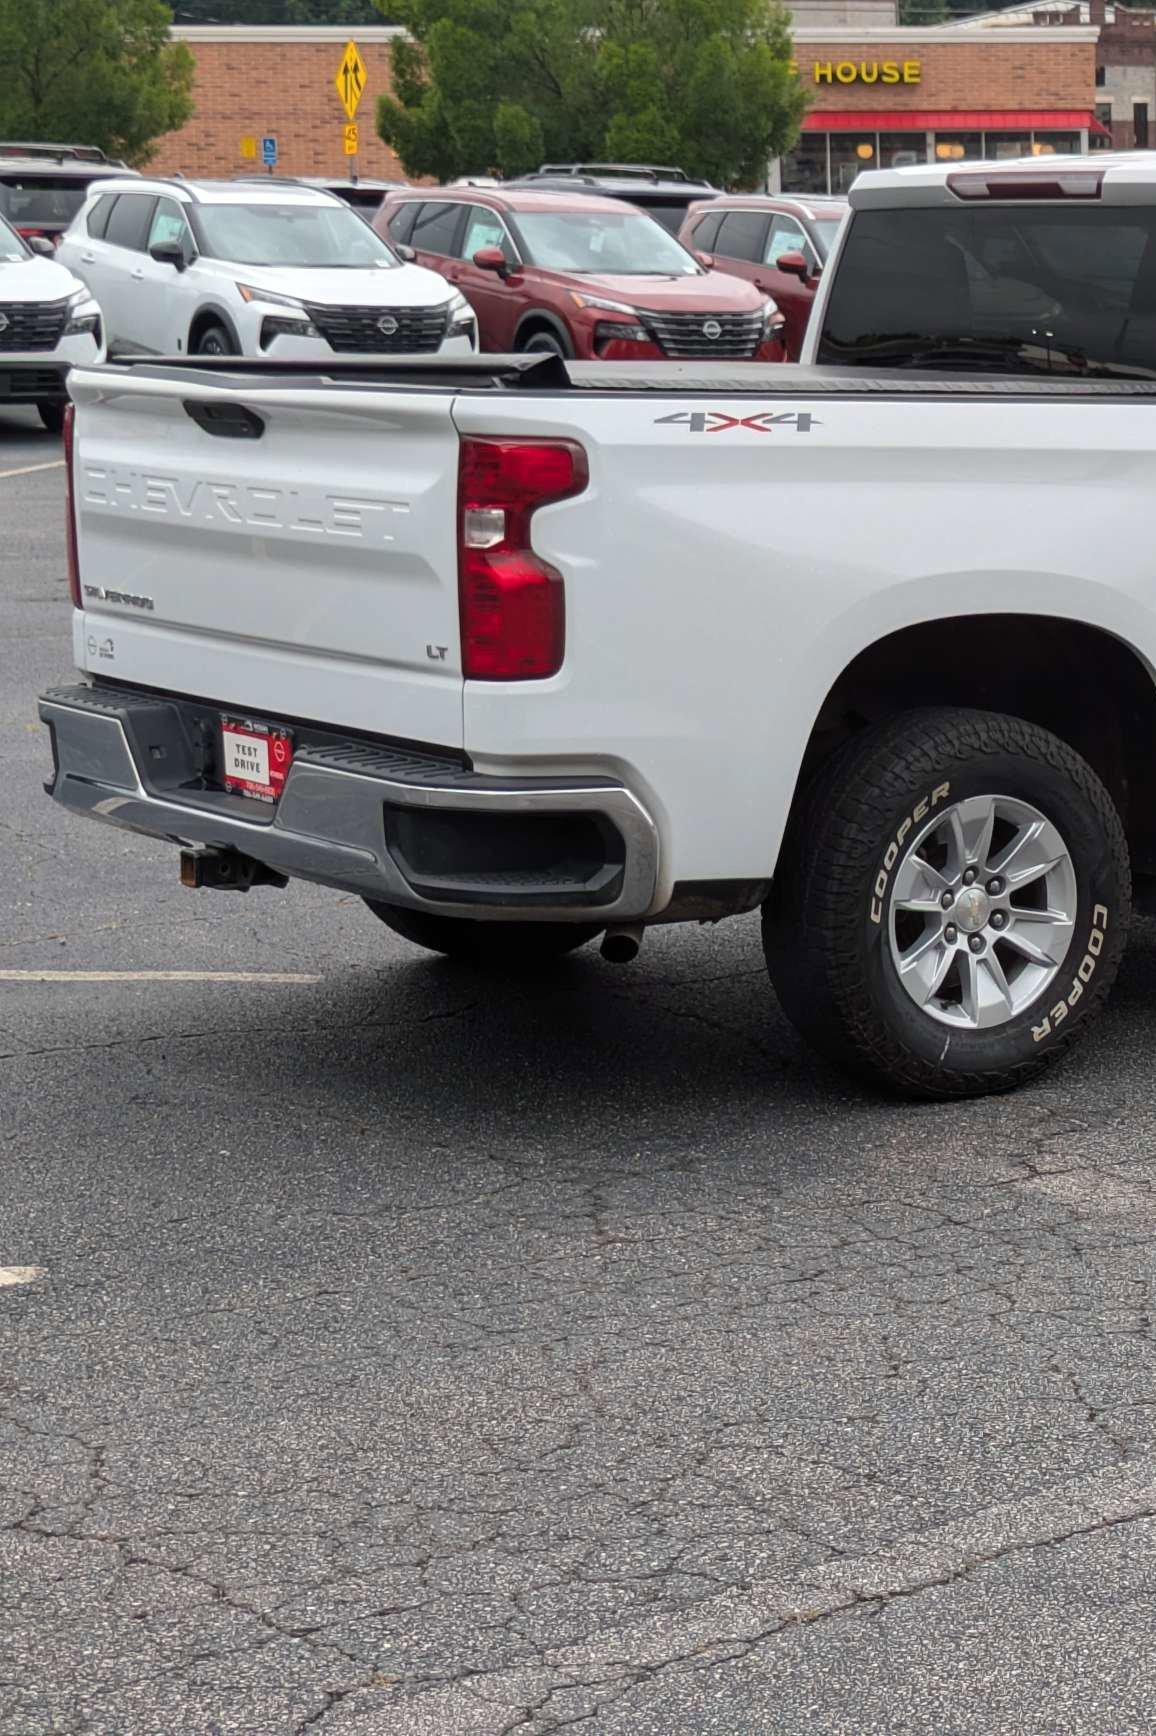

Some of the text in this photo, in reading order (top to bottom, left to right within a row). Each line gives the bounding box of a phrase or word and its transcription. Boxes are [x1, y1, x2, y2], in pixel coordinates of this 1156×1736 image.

[814, 60, 922, 84] HOUSE
[84, 467, 410, 541] CHEVROLET
[426, 644, 449, 661] LT
[235, 743, 258, 758] TEST
[234, 758, 260, 774] DRIVE
[870, 781, 950, 924] COOPER
[1030, 903, 1108, 1042] COOPER
